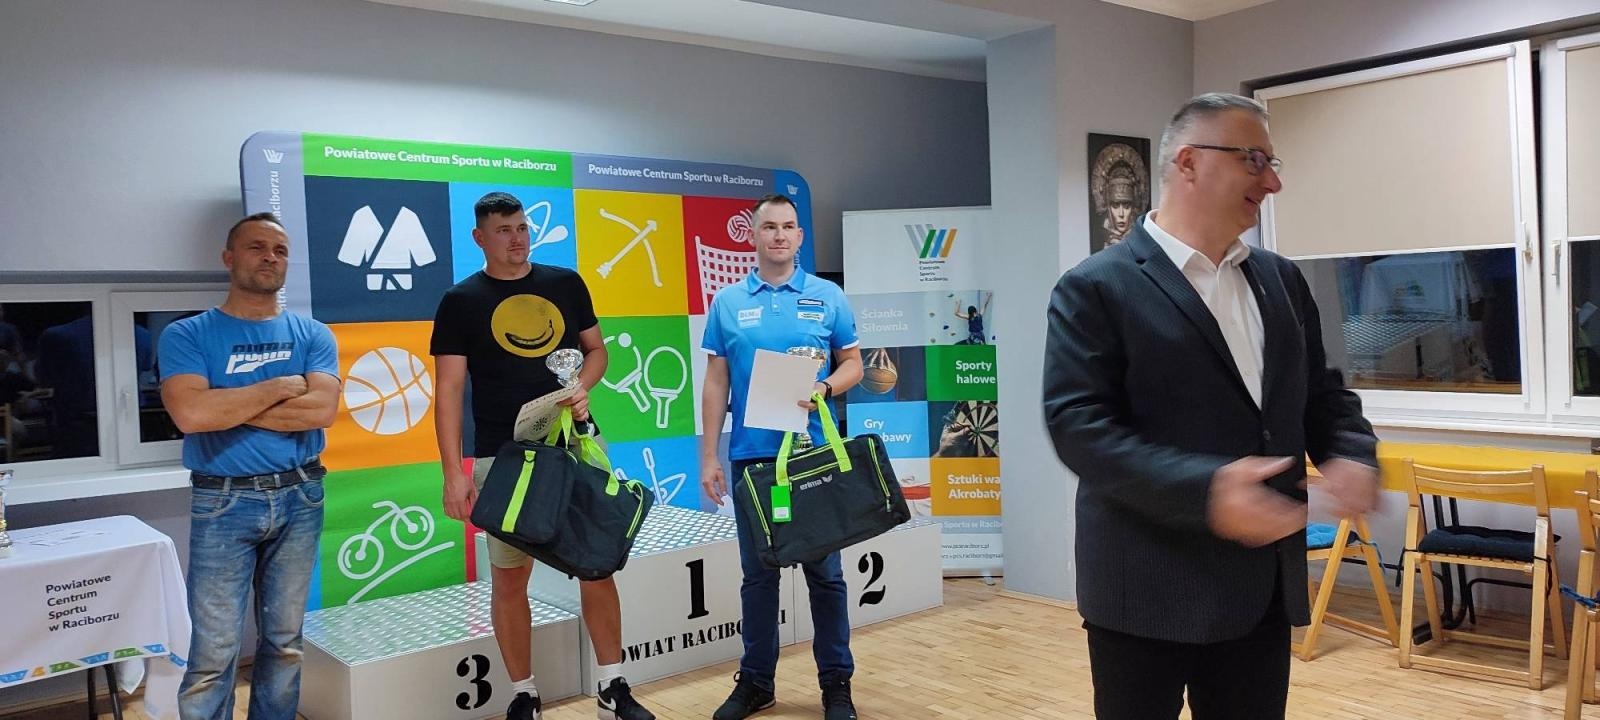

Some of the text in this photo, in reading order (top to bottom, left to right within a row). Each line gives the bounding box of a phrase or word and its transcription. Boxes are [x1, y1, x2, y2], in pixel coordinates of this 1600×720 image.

[324, 146, 557, 171] Powiatowe Centrum Sportu w Raciborzu
[588, 163, 642, 177] Powiatowe
[643, 168, 682, 180] Centrum
[683, 171, 712, 183] Sportu
[723, 174, 763, 187] Raciborzu
[269, 170, 281, 220] aciborzu
[861, 307, 904, 319] Ścianka
[861, 322, 909, 333] Siłownia
[955, 360, 992, 371] Sporty
[956, 374, 996, 384] halowe
[863, 418, 885, 430] Gry
[881, 432, 913, 443] bawy
[947, 473, 983, 485] Sztuki
[45, 574, 112, 593] Powiatowe
[857, 551, 887, 608] 2
[47, 589, 98, 607] Centrum
[685, 559, 710, 620] 1
[48, 604, 87, 620] Sportu
[49, 612, 120, 632] w Raciborzu
[620, 635, 676, 664] OWIAT
[455, 653, 493, 711] 3
